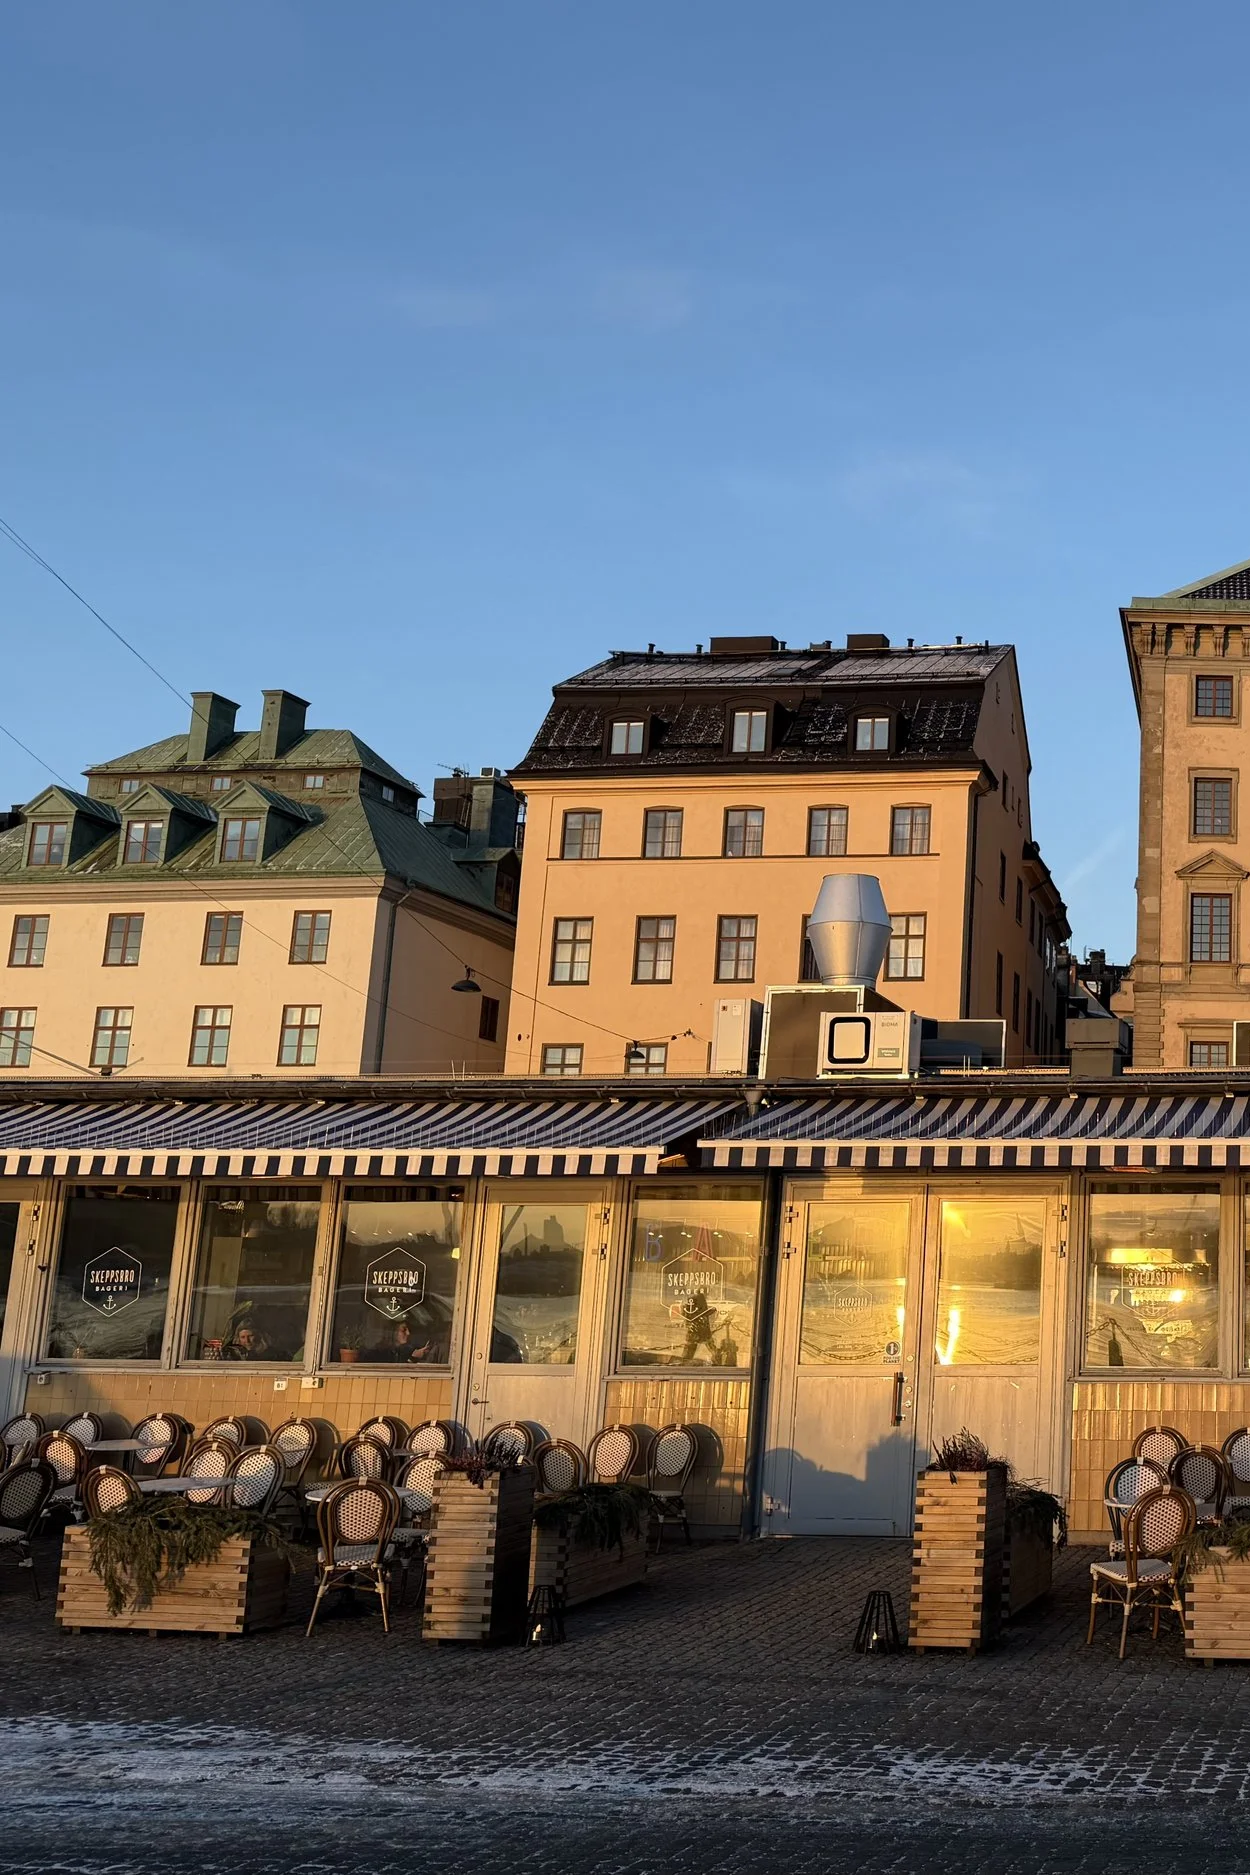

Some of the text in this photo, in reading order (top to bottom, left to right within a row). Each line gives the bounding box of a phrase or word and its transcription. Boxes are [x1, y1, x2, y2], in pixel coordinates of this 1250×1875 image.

[90, 1269, 135, 1284] SKEPPSBRO
[372, 1270, 419, 1285] SKEPPSBRO
[667, 1271, 716, 1287] SKEPPSBRO
[1128, 1271, 1178, 1287] SKEPPSBRO
